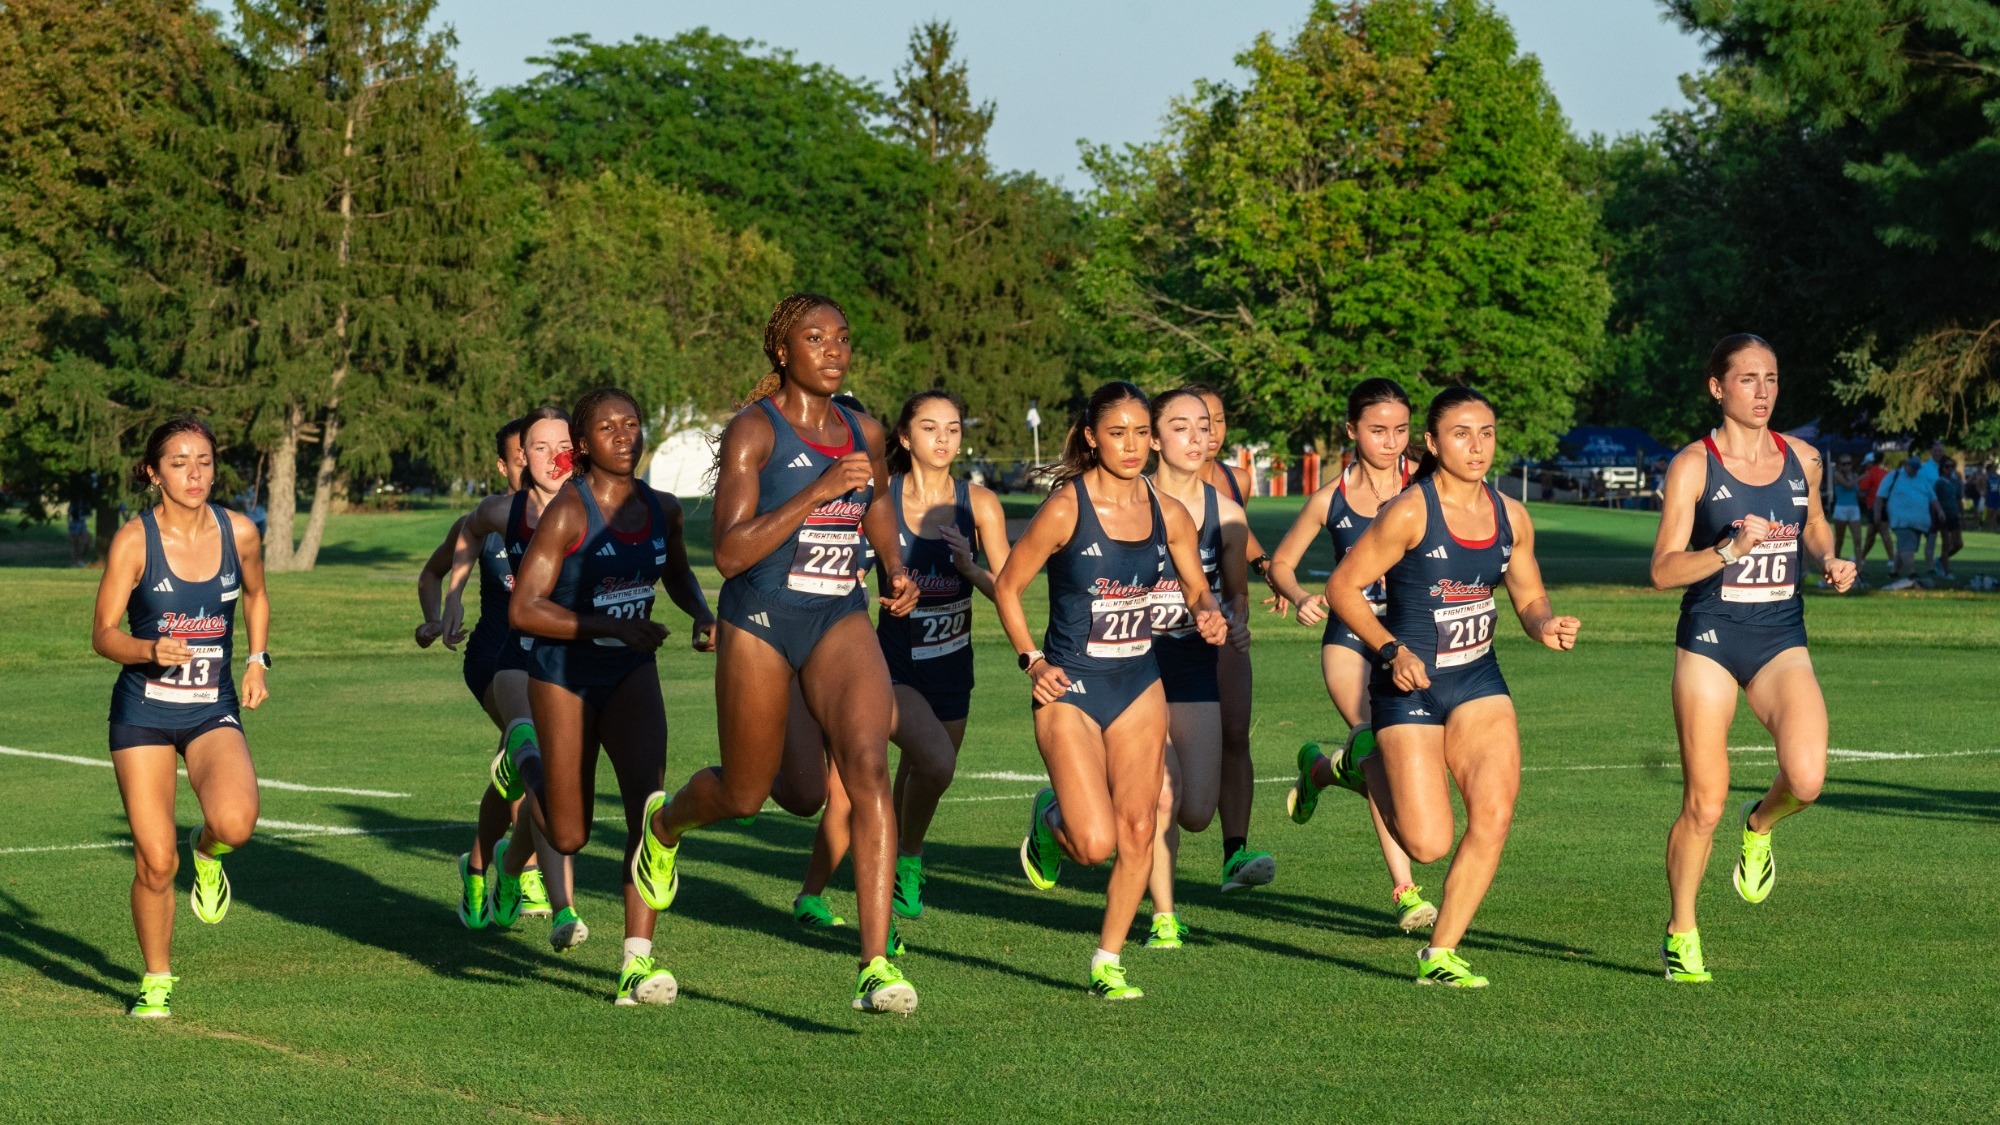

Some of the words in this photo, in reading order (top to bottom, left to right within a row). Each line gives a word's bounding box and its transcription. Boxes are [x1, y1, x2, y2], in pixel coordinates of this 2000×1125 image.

[807, 531, 841, 540] FIGHTING
[804, 545, 853, 576] 222
[1736, 555, 1787, 584] 216
[601, 590, 632, 601] FIGHTING
[917, 604, 951, 613] FIGHTING
[158, 611, 226, 634] Flames
[1442, 604, 1475, 617] FIGHTING
[922, 612, 966, 643] 220
[1102, 610, 1145, 640] 217
[1450, 615, 1491, 650] 218
[160, 659, 210, 686] 213
